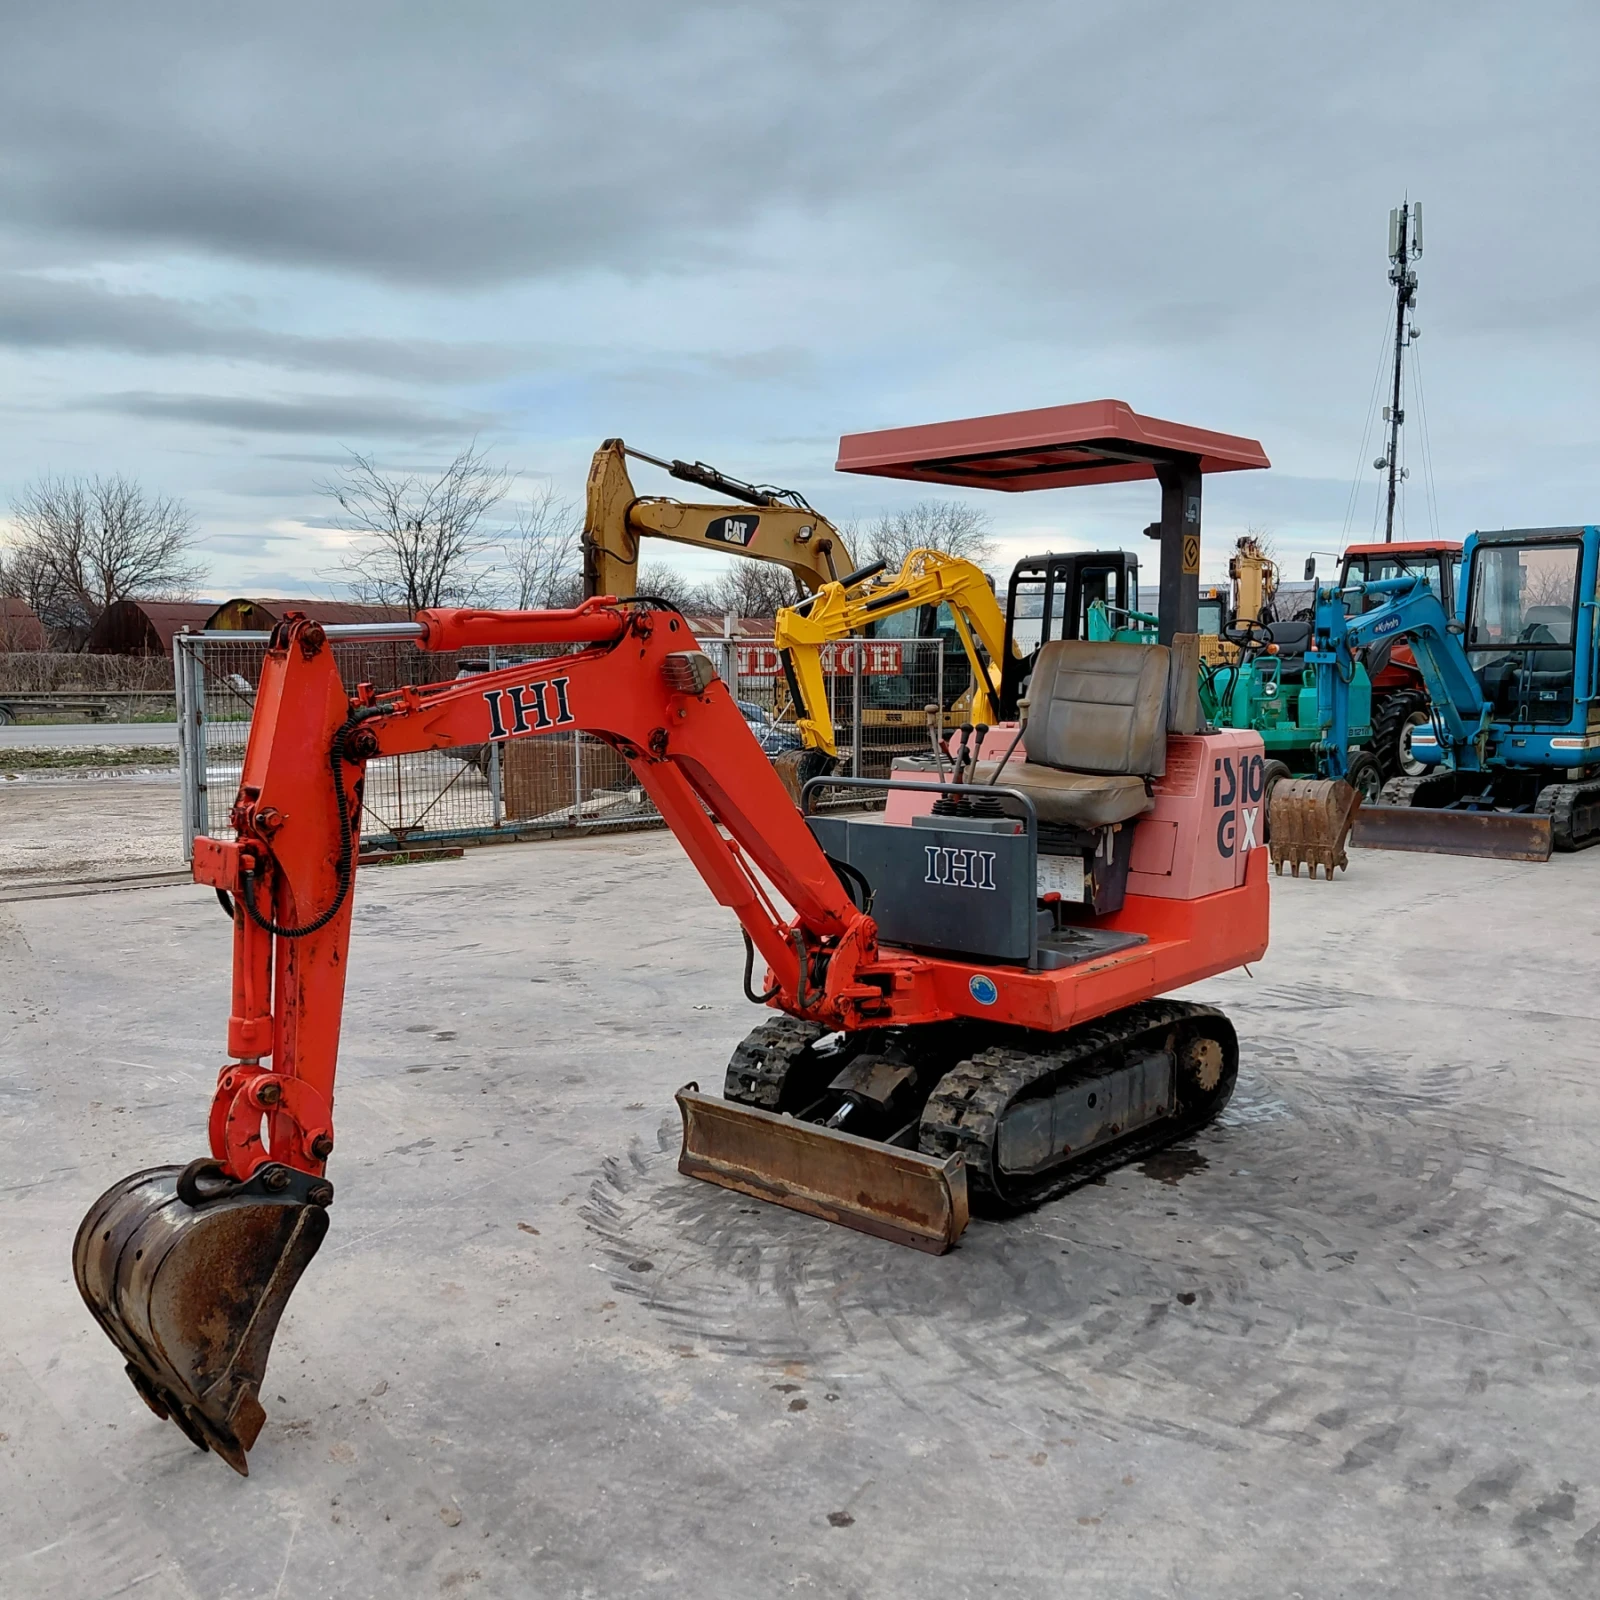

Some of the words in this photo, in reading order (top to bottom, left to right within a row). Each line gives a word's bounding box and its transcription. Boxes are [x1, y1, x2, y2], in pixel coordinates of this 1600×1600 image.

[724, 518, 748, 544] CAT
[483, 676, 575, 741] IHI
[924, 845, 997, 891] IHI
